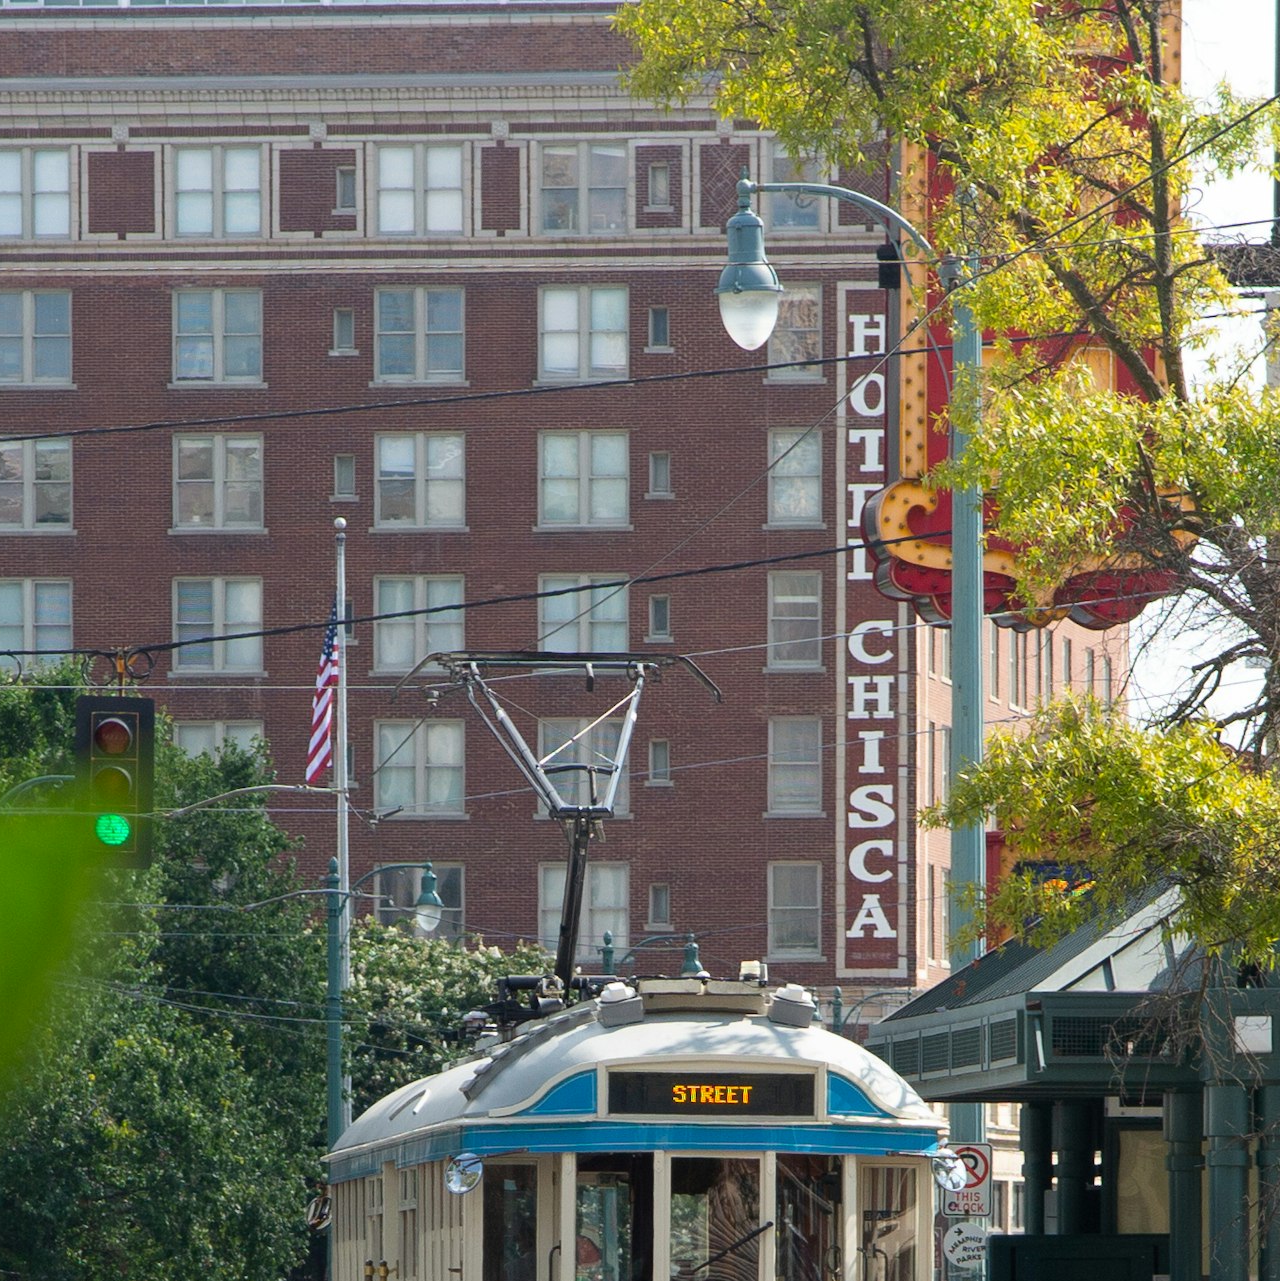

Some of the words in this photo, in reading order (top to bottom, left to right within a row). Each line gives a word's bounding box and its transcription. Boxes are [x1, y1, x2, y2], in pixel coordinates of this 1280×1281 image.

[846, 620, 897, 938] CHISCA
[672, 1085, 752, 1104] STREET
[955, 1192, 981, 1202] THIS
[948, 1236, 982, 1254] MEMPHIS
[956, 1254, 982, 1264] PARKS
